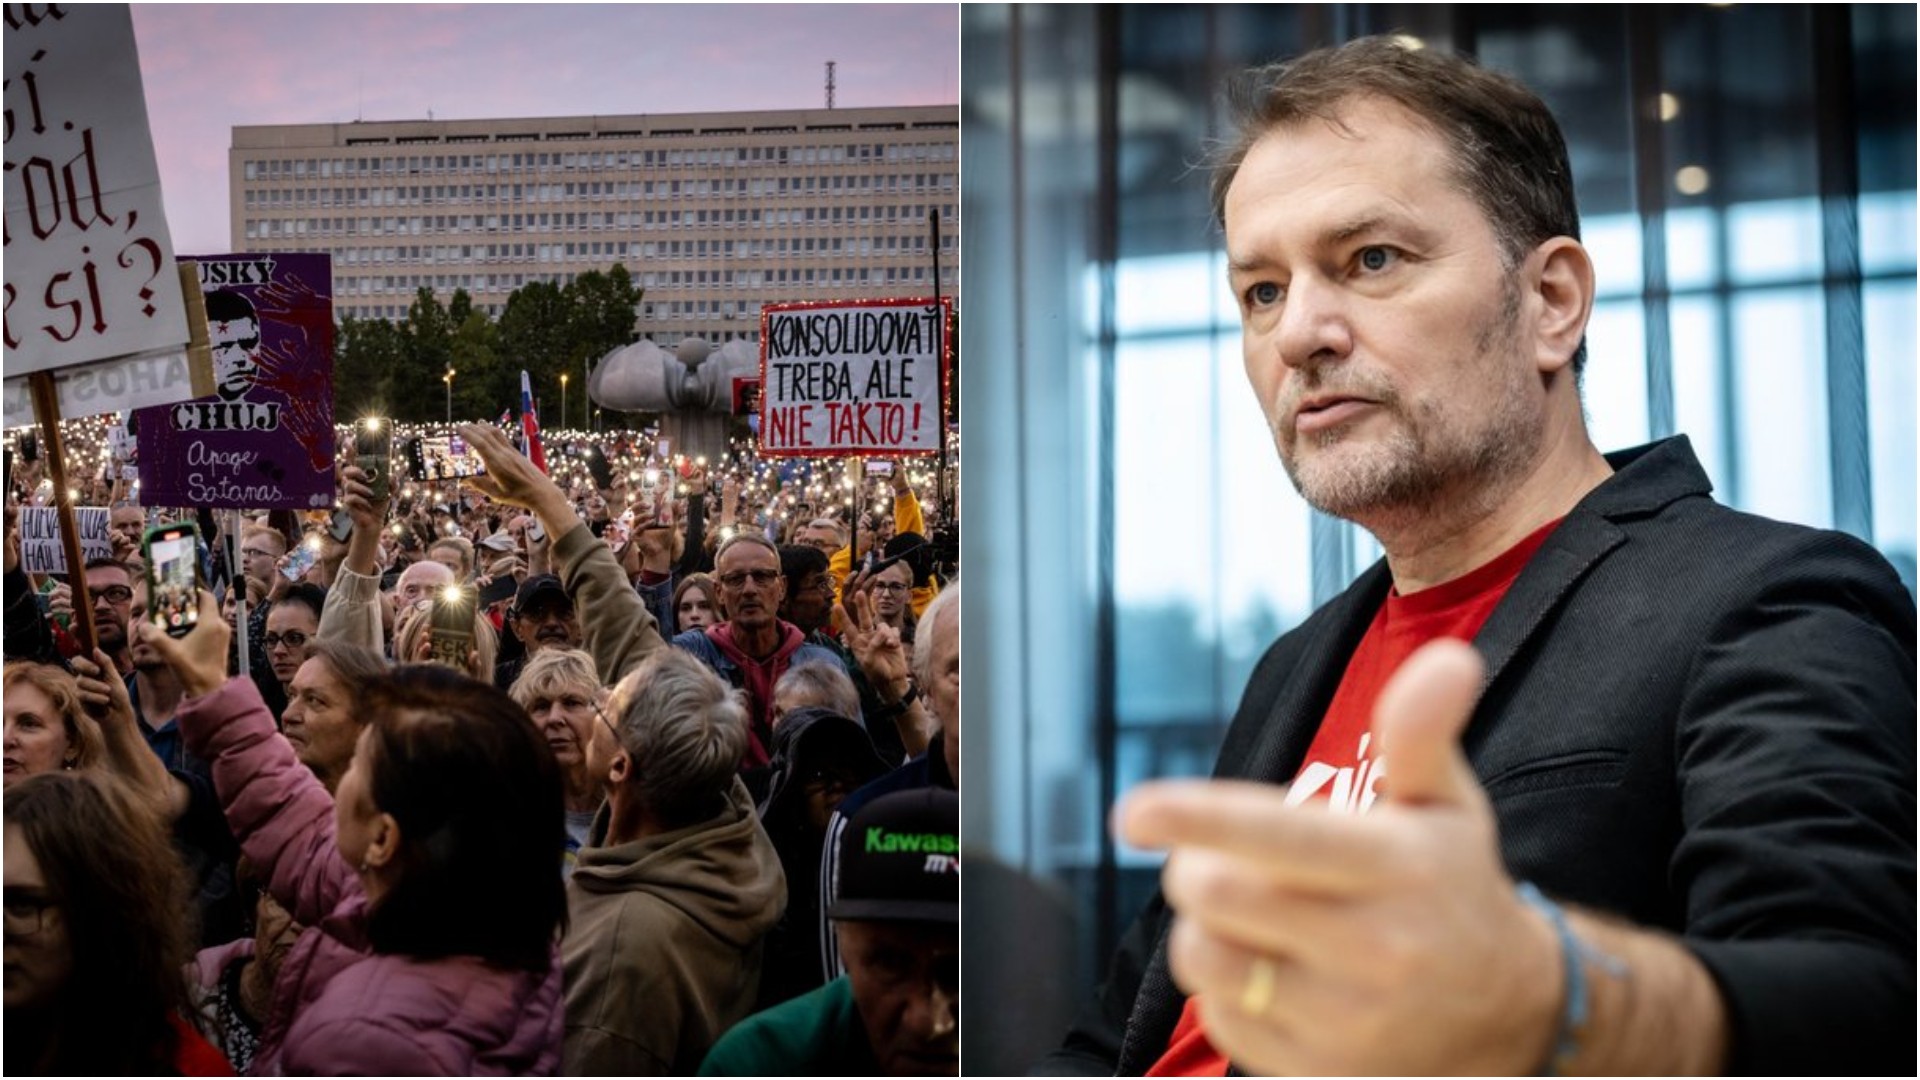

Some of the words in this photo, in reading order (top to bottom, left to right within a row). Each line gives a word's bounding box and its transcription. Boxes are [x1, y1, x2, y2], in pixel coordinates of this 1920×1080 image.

[768, 306, 940, 358] KONSOLIDOVAŤ
[773, 361, 859, 405] TREBA,
[865, 359, 914, 398] ALE
[171, 402, 281, 431] CHUJ
[769, 405, 812, 447] NIE
[188, 440, 258, 478] Apage
[865, 827, 959, 853] Kawas
